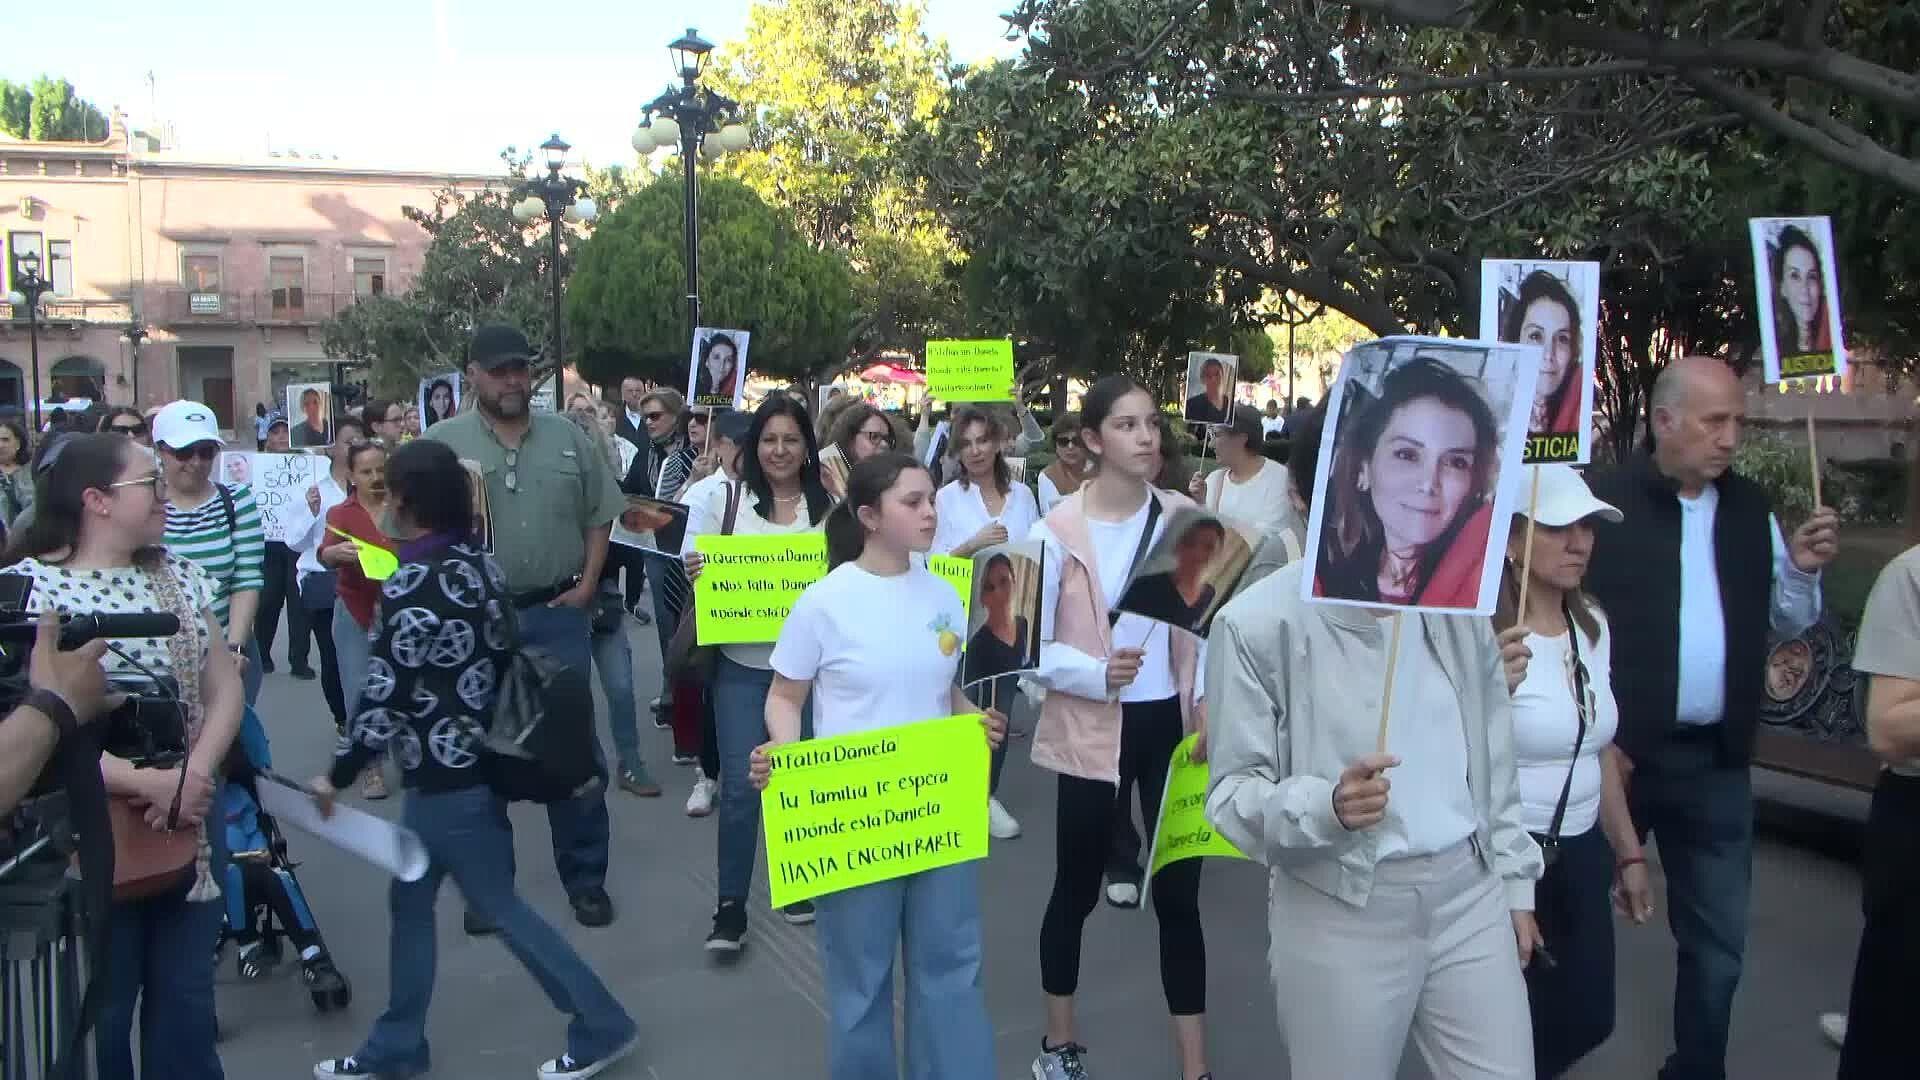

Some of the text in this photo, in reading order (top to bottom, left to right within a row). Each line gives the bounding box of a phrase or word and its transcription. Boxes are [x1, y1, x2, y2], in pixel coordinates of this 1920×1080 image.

[780, 791, 799, 811] Tu
[877, 780, 891, 796] te
[898, 771, 949, 797] espera
[885, 801, 941, 825] Daniela
[780, 831, 964, 885] HASTA ENCONTRARTE
